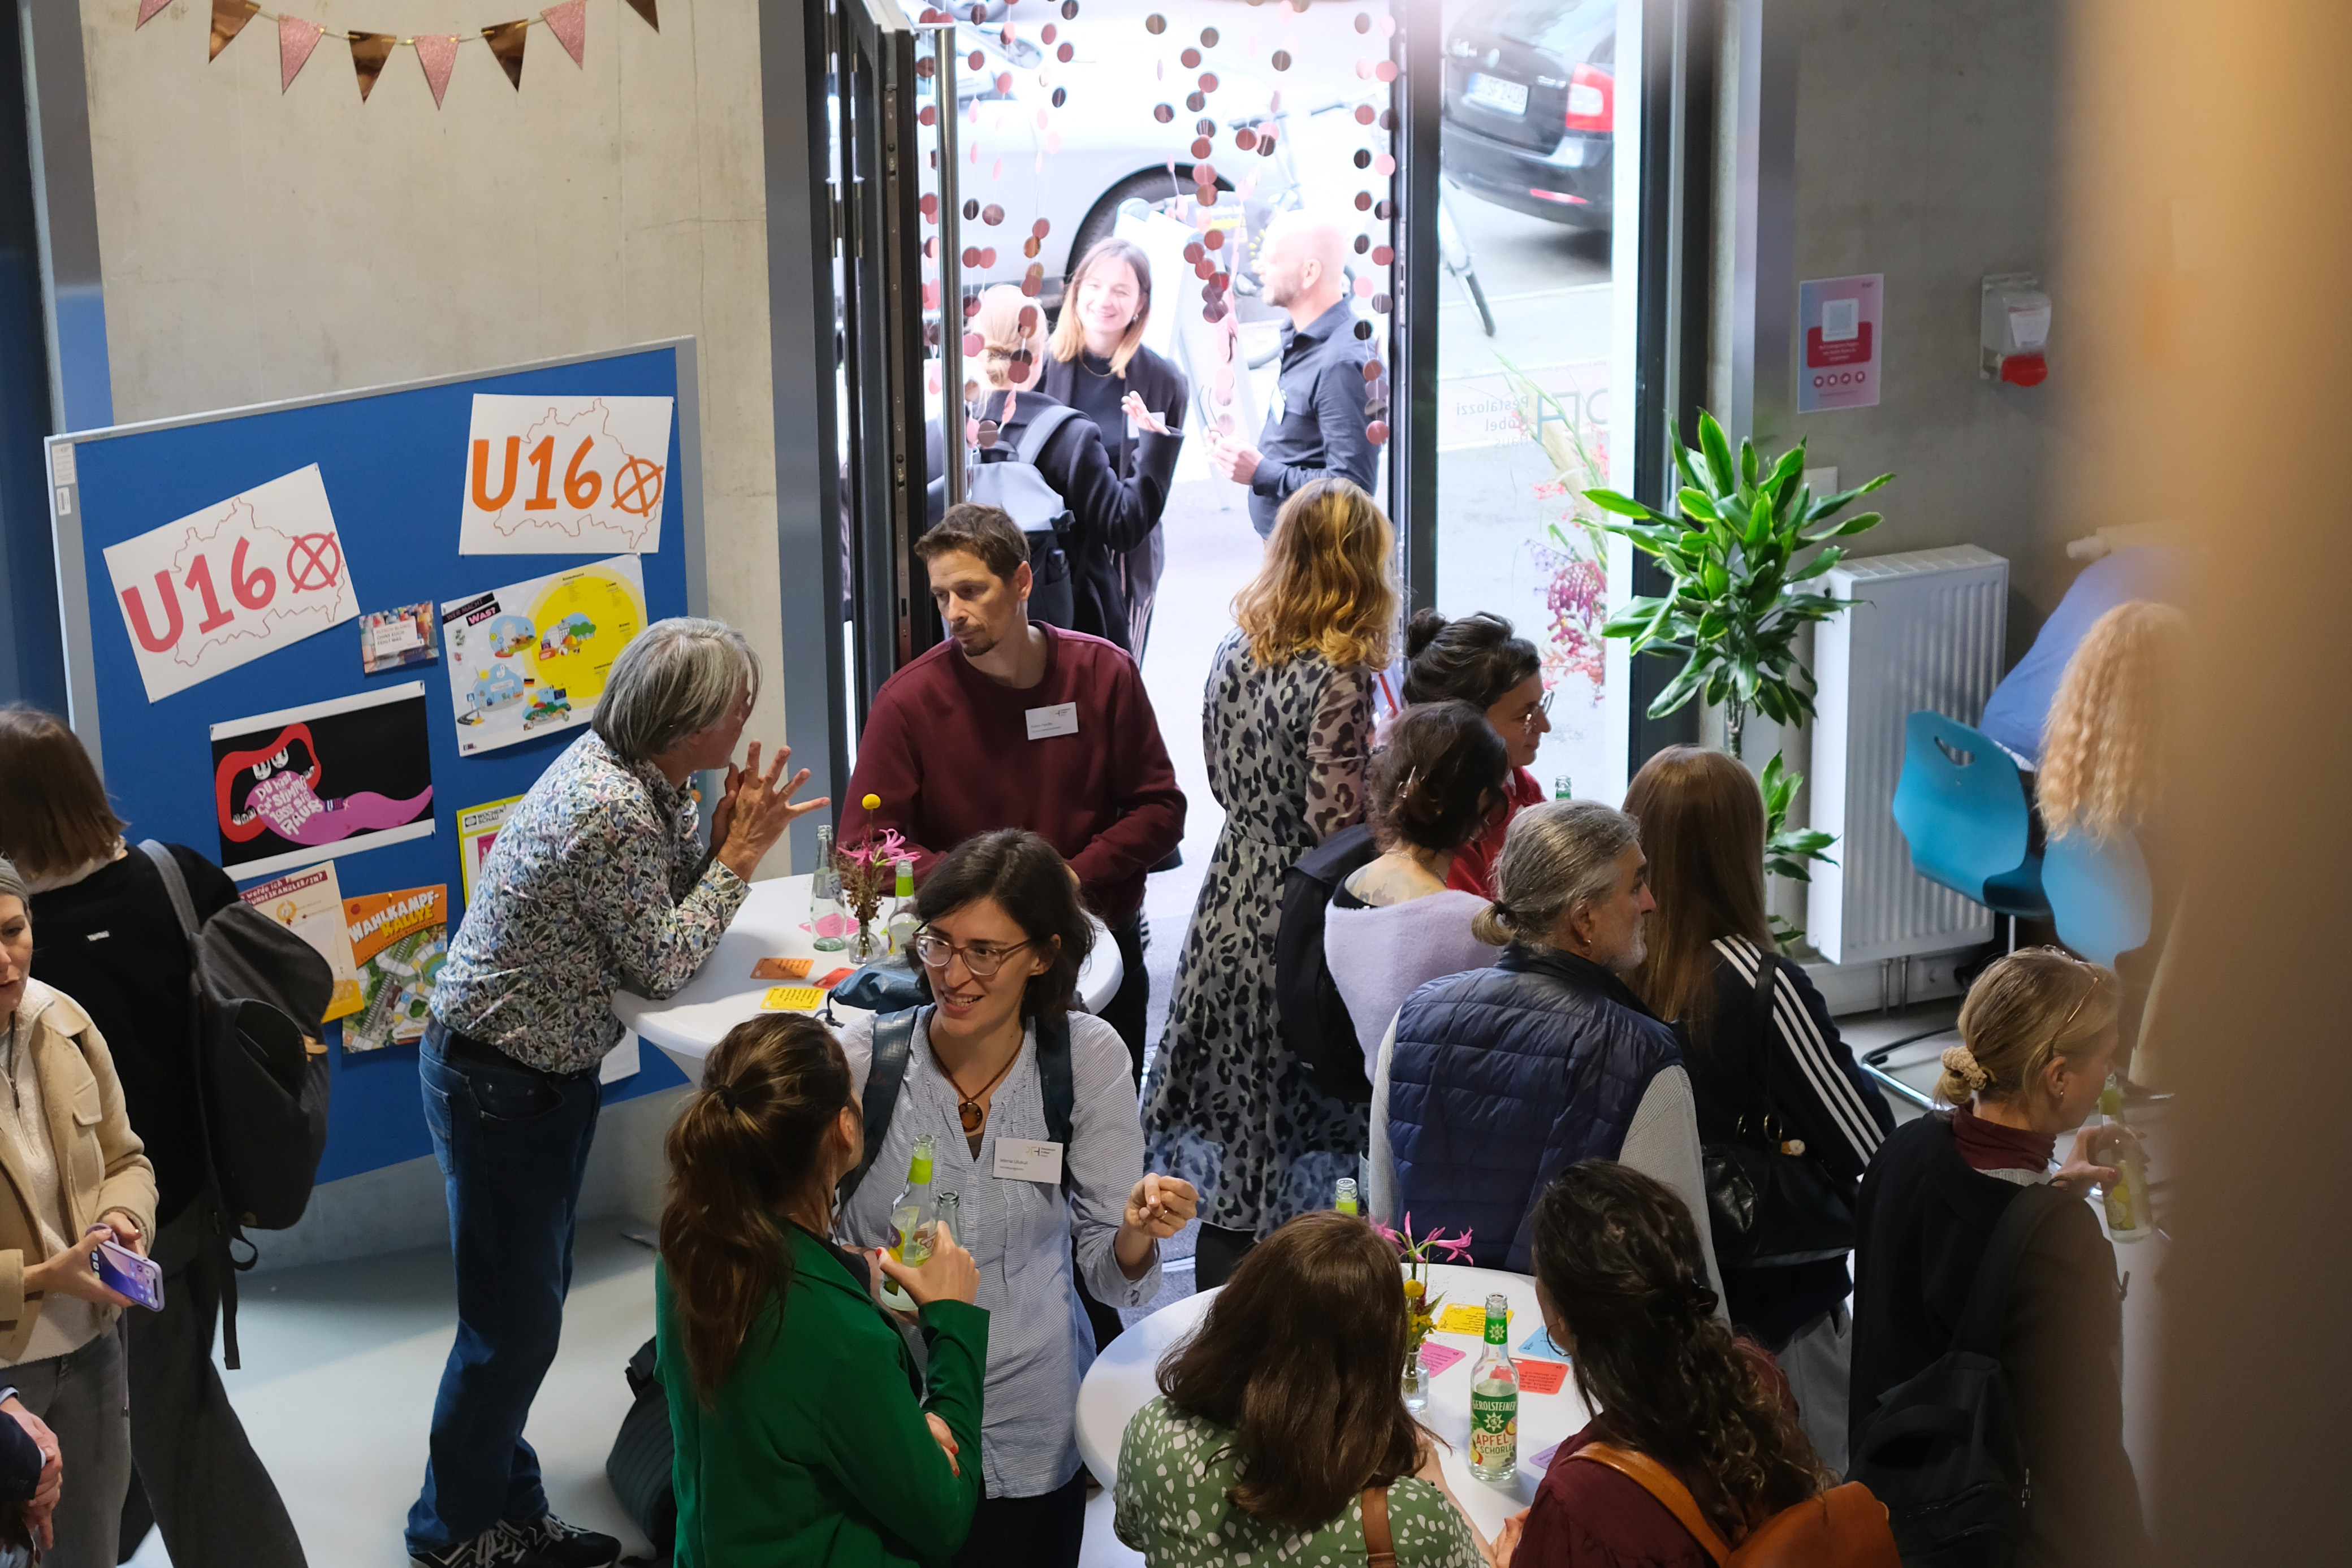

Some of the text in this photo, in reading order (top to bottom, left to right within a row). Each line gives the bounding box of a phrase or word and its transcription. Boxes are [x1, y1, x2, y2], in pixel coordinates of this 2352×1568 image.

[472, 435, 602, 512] U16
[121, 536, 276, 653] U16
[447, 599, 483, 620] WER MACHT
[468, 607, 496, 625] WAS?
[477, 808, 504, 818] WOCHEN
[478, 815, 499, 824] SCHAU
[380, 903, 434, 938] RALLYE
[1472, 1399, 1516, 1411] GEROLSTEINER
[1476, 1433, 1509, 1446] APFEL
[1480, 1443, 1513, 1454] SCHORLE
